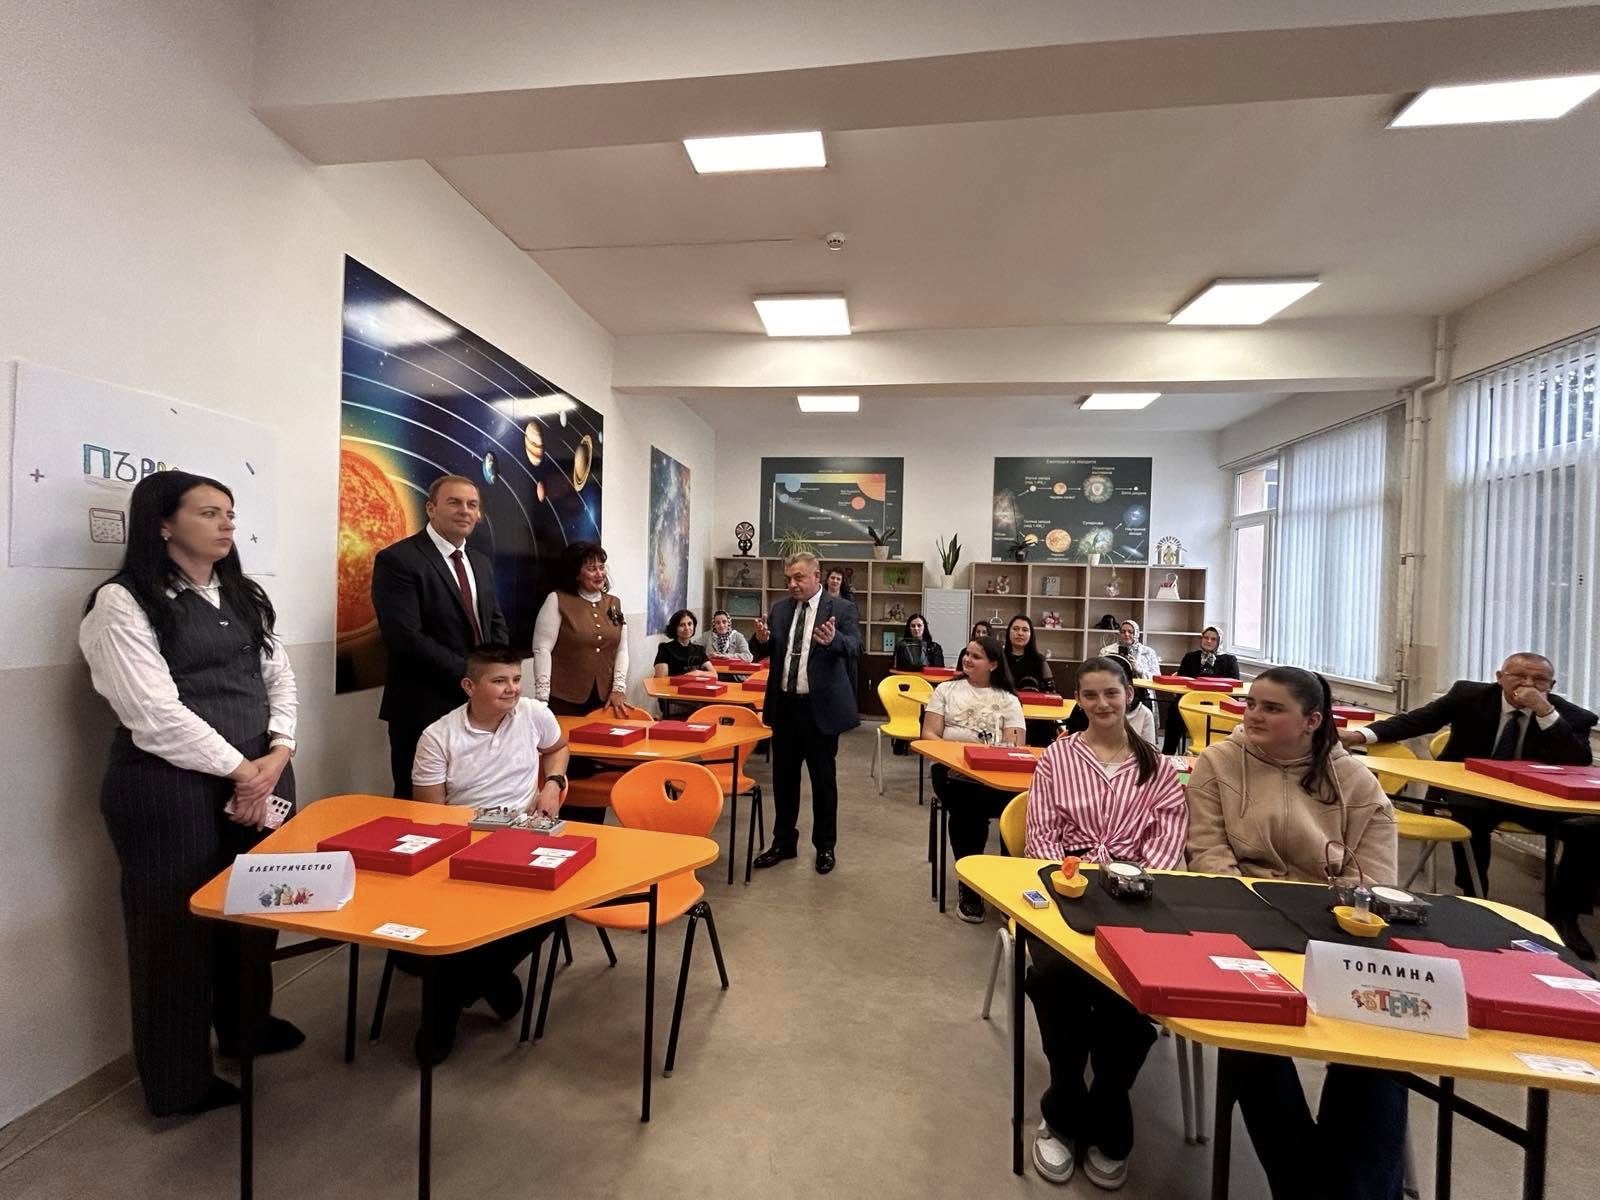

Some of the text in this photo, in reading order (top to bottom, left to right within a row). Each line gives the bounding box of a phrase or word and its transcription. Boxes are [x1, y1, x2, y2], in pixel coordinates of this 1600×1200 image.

[248, 863, 333, 873] ЕЛЕКТРИЧЕСТВО
[1342, 959, 1435, 983] ТОПЛИНА
[1361, 989, 1421, 1017] STEM
